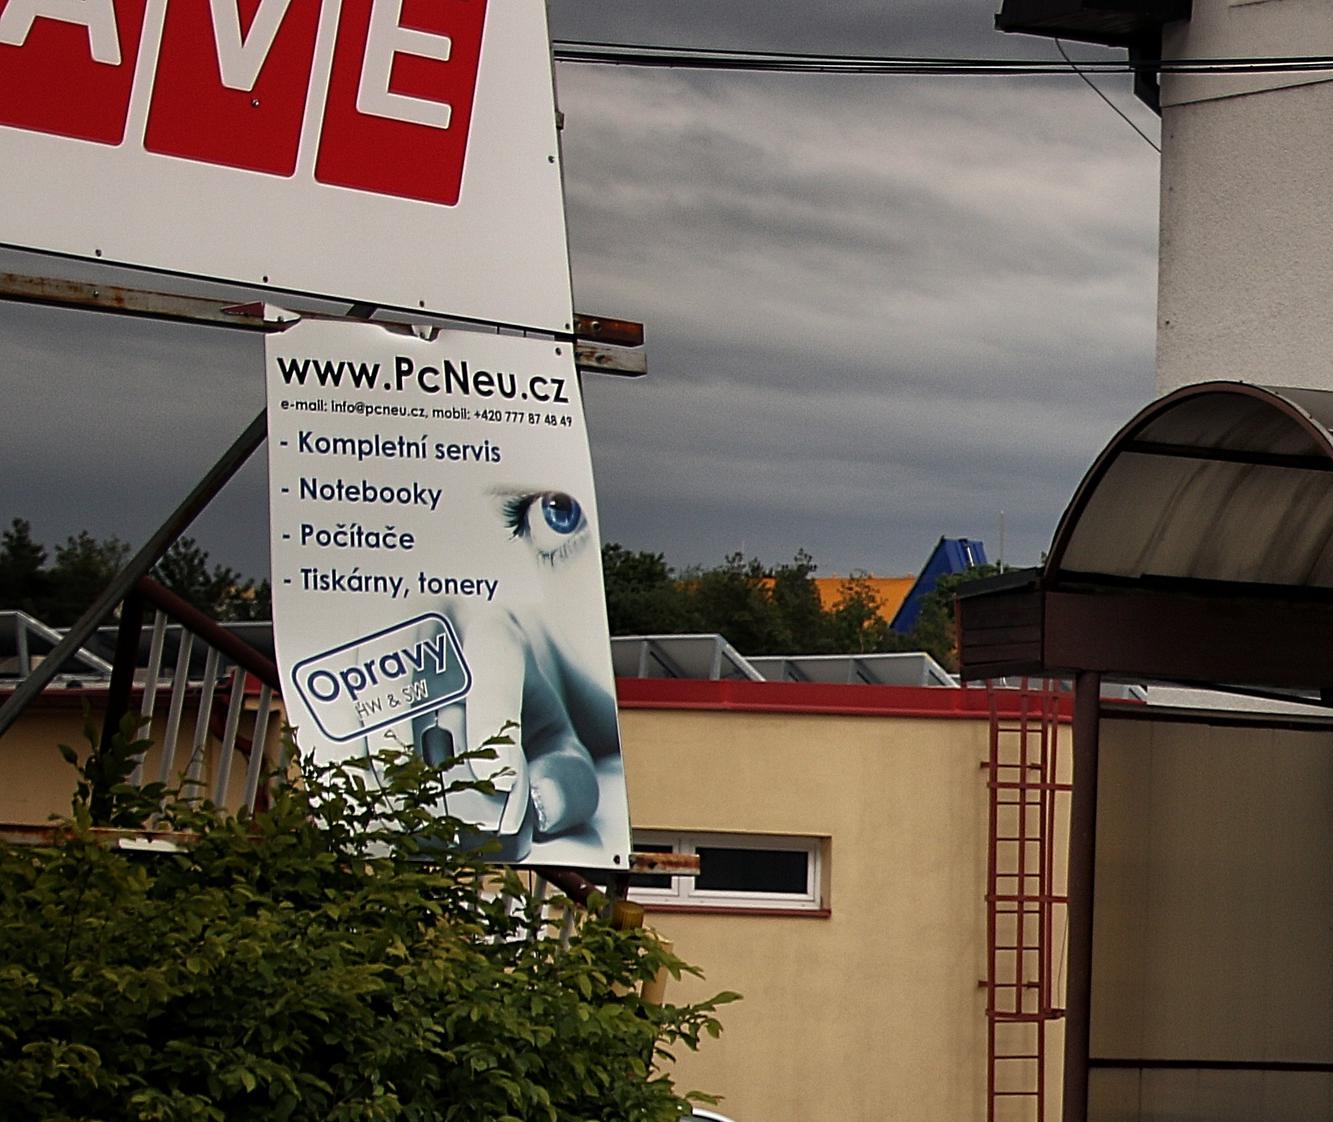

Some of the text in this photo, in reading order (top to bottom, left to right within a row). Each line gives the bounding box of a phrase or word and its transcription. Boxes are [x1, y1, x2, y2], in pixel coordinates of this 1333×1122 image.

[276, 355, 570, 404] www.PcNeu.cz
[280, 399, 328, 412] e-mail:
[331, 400, 429, 419] info@pcneu.cz,
[432, 408, 471, 421] mobil:
[474, 410, 502, 422] +420
[505, 411, 525, 424] 777
[528, 413, 541, 425] 87
[544, 414, 557, 426] 48
[298, 430, 501, 463] Kompletní servis
[300, 477, 442, 511] Notebooky
[301, 522, 414, 551] Počítače
[301, 567, 498, 601] Tiskárny, tonery
[306, 633, 447, 702] Opravy
[354, 679, 428, 719] HW & SW
